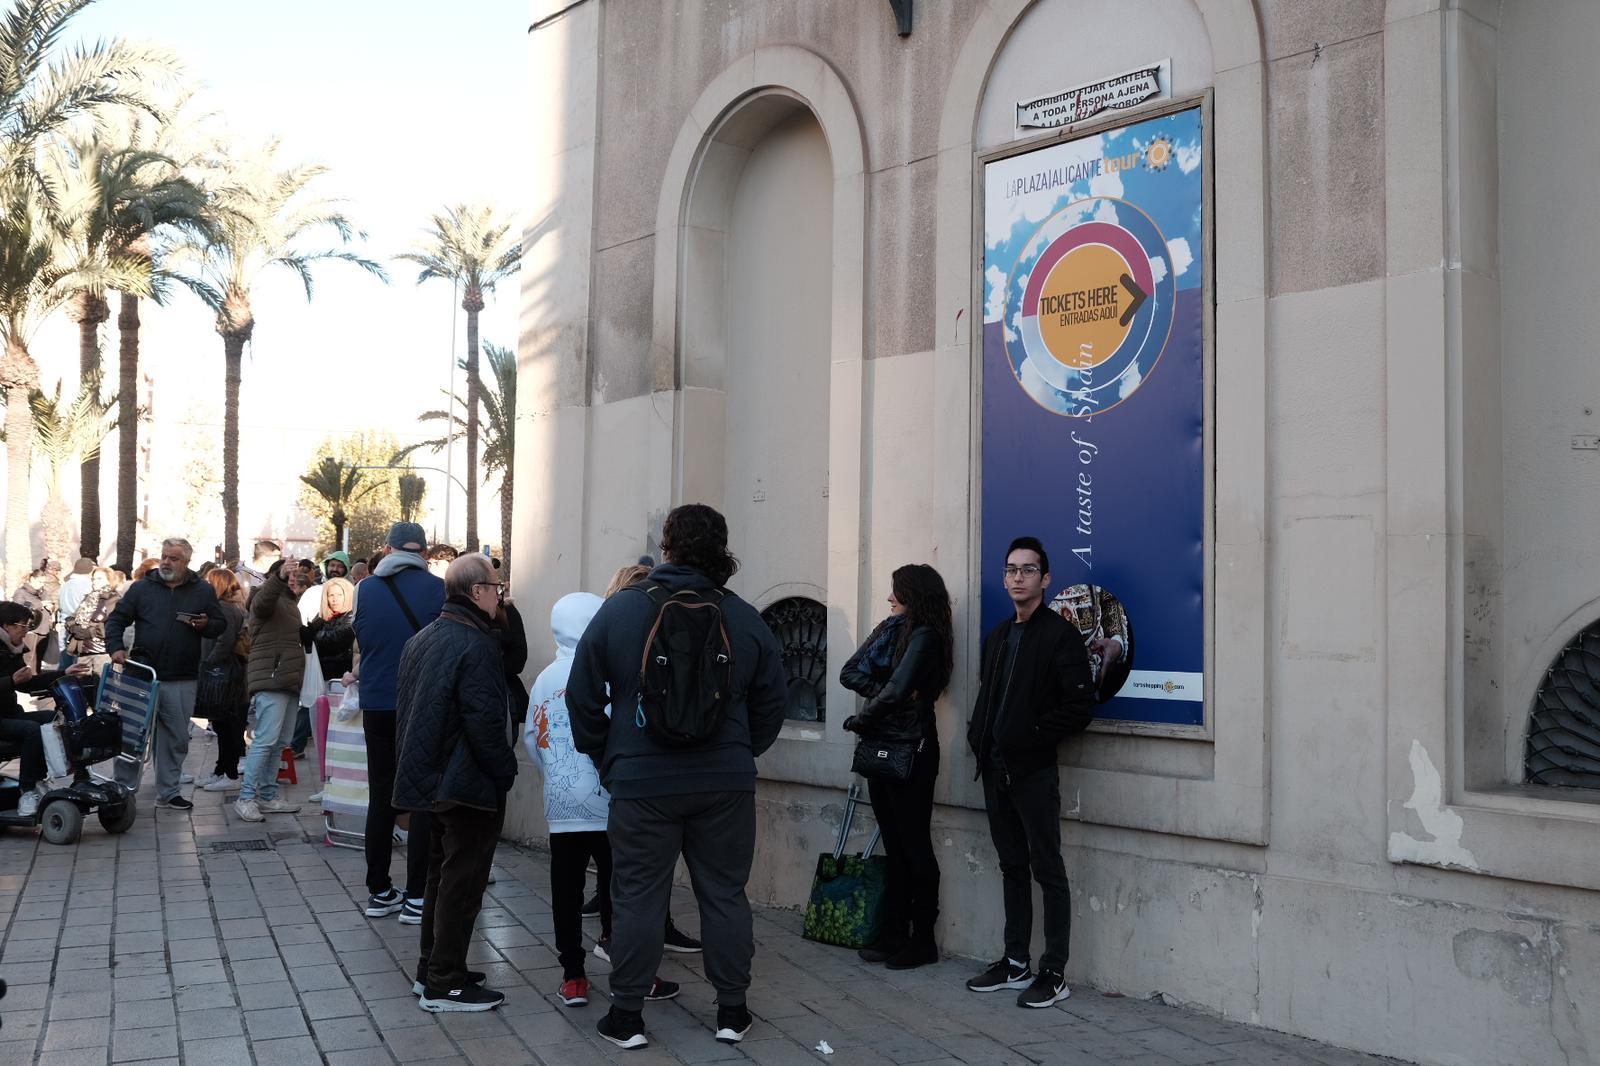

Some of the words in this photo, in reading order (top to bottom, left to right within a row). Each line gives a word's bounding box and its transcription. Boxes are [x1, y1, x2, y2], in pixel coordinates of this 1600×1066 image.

[1024, 90, 1077, 111] ROHIBIDO
[1079, 82, 1106, 96] FIJAR
[1033, 112, 1040, 121] A
[1041, 105, 1067, 118] TODA
[1069, 92, 1115, 111] PERSONA
[1117, 81, 1150, 98] AJENA
[1040, 291, 1086, 316] TICKETS
[1087, 285, 1118, 307] HERE
[1060, 309, 1099, 327] ENTRADAS
[1071, 341, 1099, 423] Spain
[1070, 431, 1098, 464] of
[1076, 472, 1092, 535] taste
[1071, 544, 1092, 570] A
